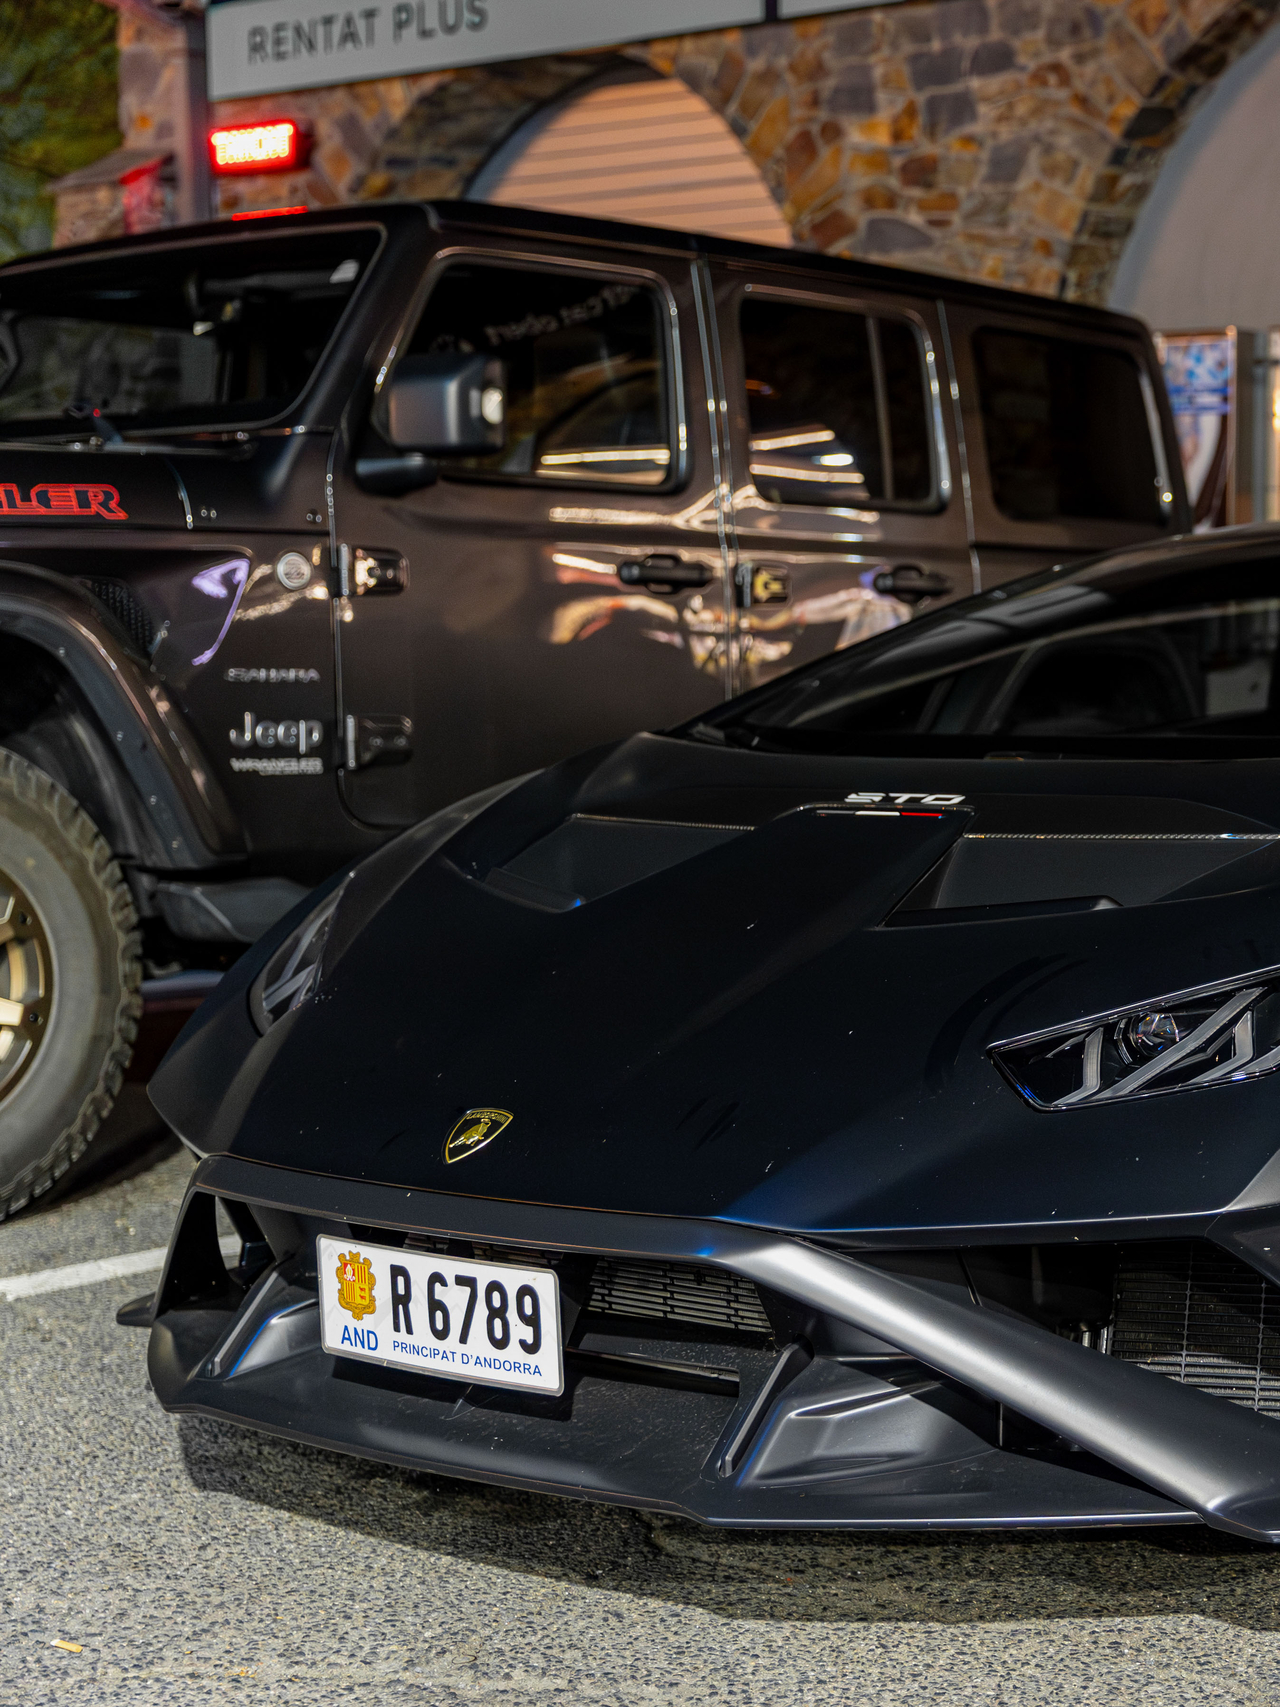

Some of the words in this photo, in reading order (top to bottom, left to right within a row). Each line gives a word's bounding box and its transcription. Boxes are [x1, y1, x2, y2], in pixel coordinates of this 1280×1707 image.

[247, 7, 380, 65] RENTAT
[392, 0, 490, 45] PLUS
[0, 483, 129, 520] LER
[228, 711, 324, 755] Jeep
[844, 792, 966, 805] STO
[389, 1264, 414, 1336] R
[426, 1271, 543, 1355] 6789
[340, 1325, 379, 1352] AND
[392, 1340, 457, 1363] PRINCIPAT
[461, 1353, 543, 1377] D'ANDORRA
